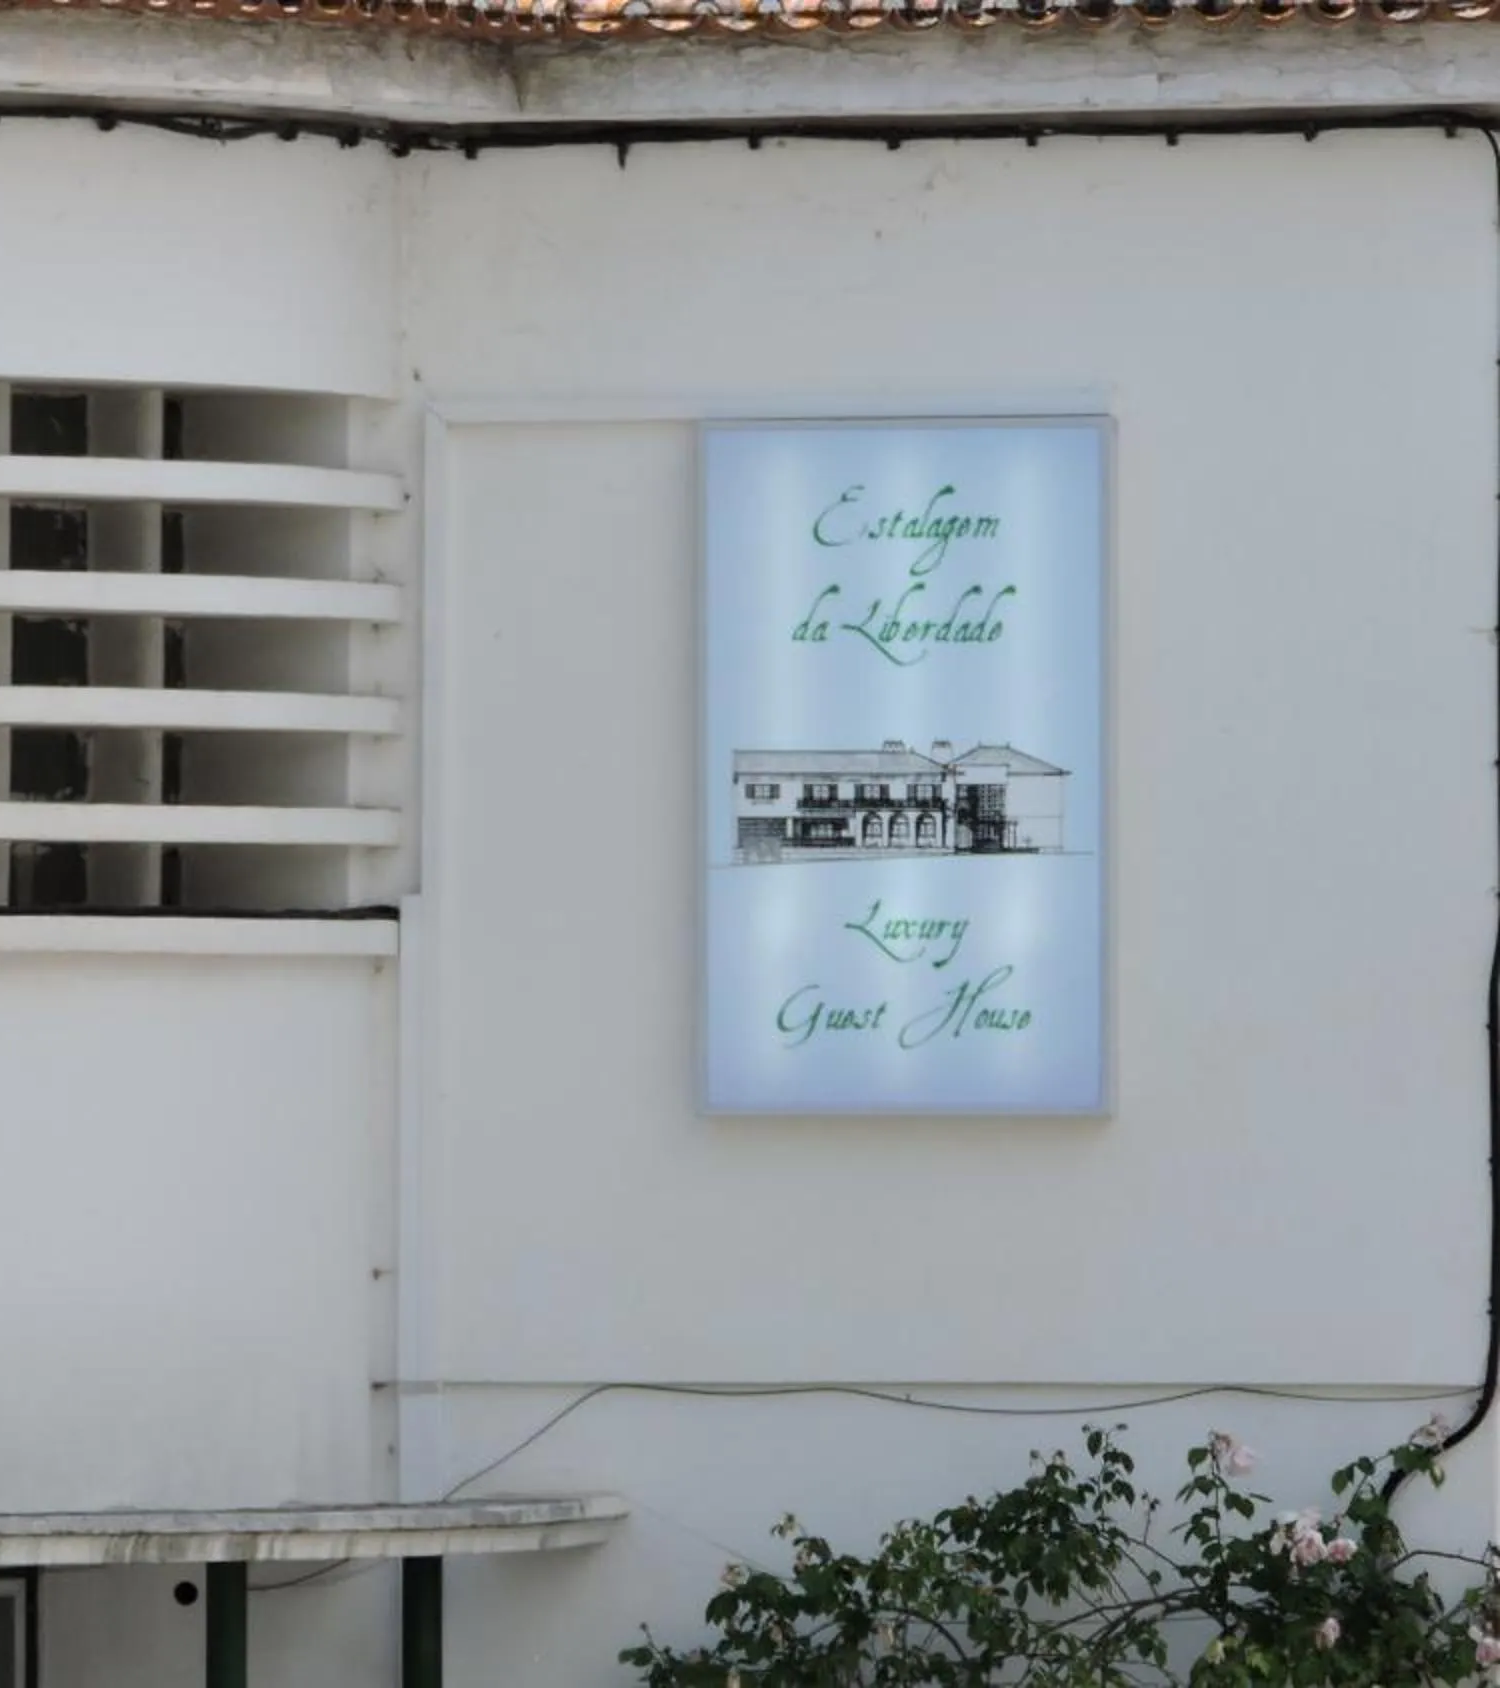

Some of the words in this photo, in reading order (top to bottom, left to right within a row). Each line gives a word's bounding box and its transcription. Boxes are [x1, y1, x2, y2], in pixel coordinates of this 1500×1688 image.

[812, 485, 1000, 576] Estalagem
[792, 584, 841, 642] da
[840, 583, 1017, 667] Liberdade
[844, 899, 970, 968] Luxury
[776, 984, 887, 1049] Guest
[898, 965, 1032, 1050] House
